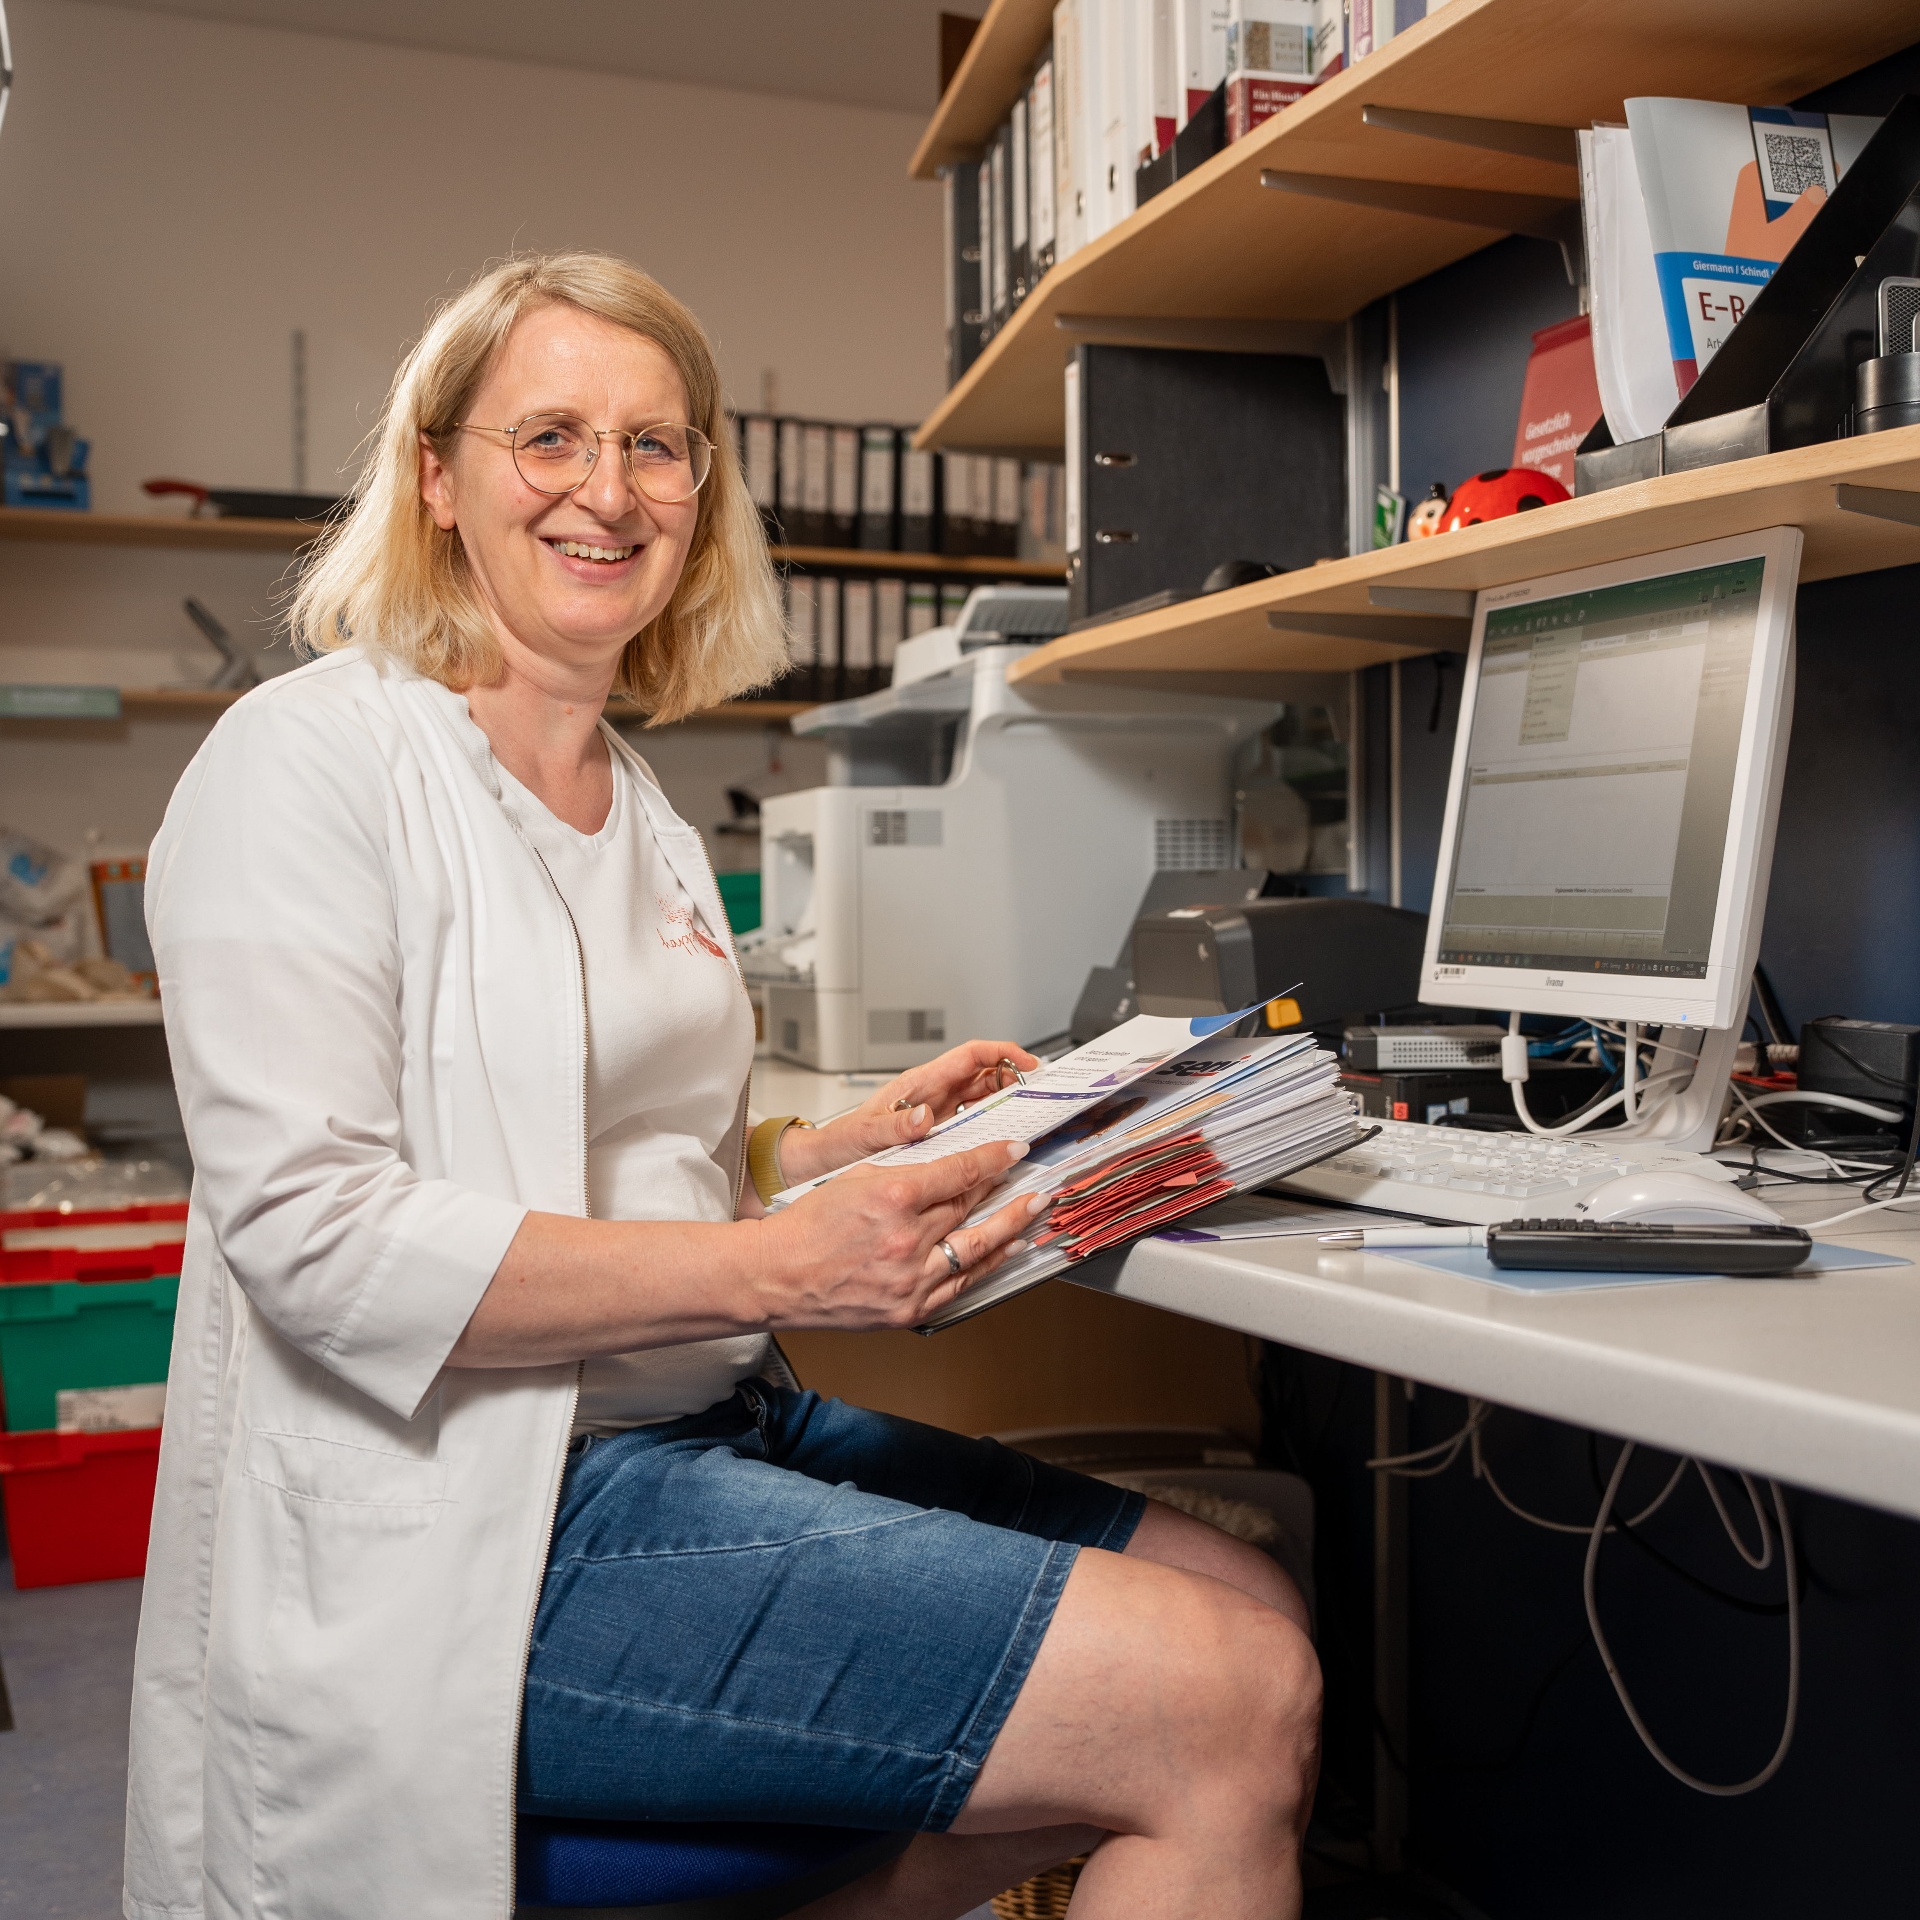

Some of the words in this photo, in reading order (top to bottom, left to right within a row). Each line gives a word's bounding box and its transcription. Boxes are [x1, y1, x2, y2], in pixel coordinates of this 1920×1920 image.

[1693, 260, 1734, 274] Giermann
[1525, 409, 1572, 441] Gesetzlich
[1155, 1054, 1252, 1077] seni
